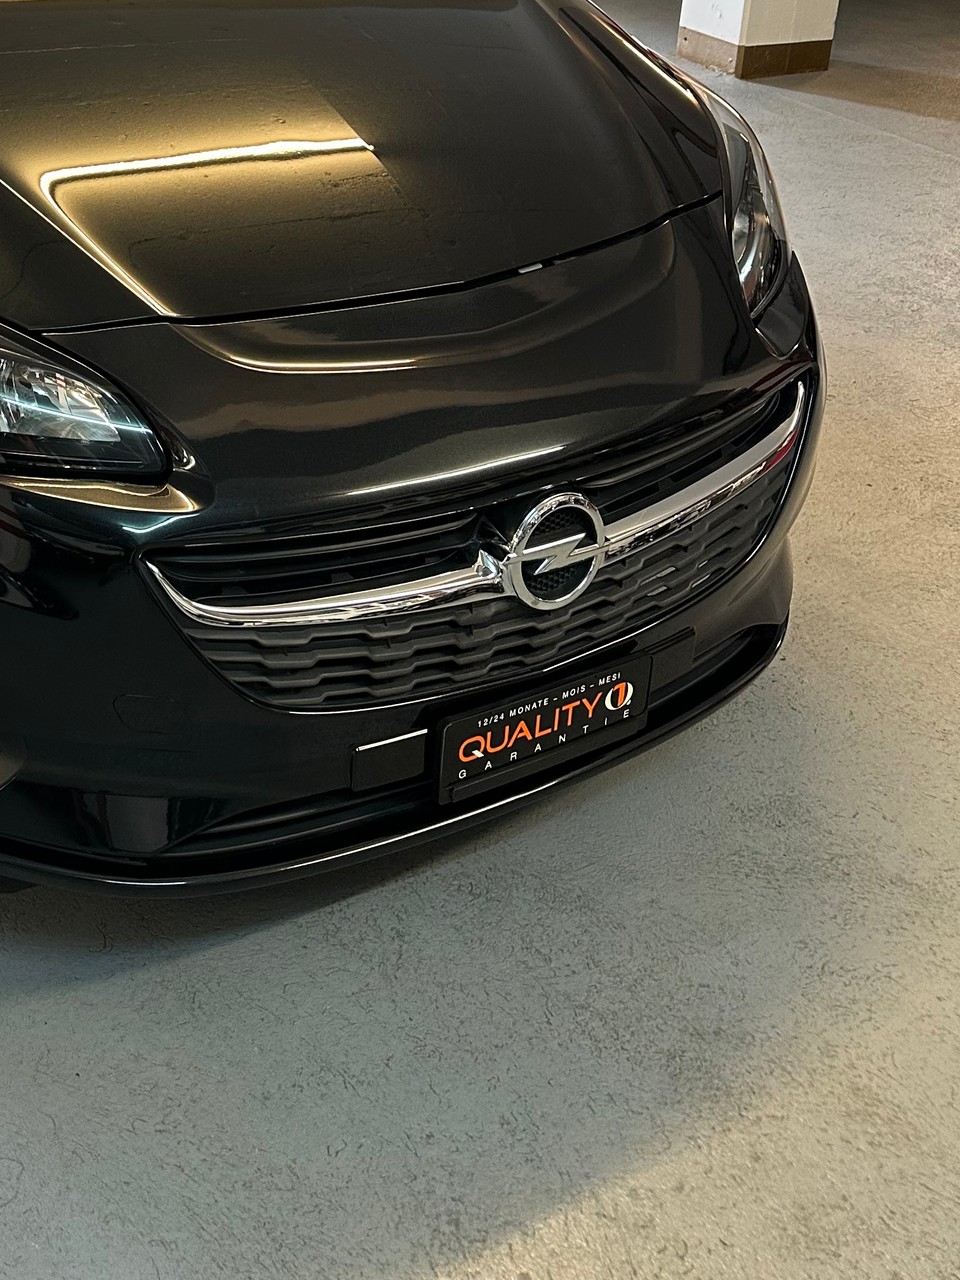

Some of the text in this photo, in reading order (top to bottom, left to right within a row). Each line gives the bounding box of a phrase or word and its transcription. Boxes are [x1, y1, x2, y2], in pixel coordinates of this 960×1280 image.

[458, 691, 603, 763] QUALITY
[477, 712, 505, 727] 12/24
[509, 697, 550, 717] MONATE
[562, 684, 586, 699] MOIS
[598, 672, 622, 686] MESI
[458, 708, 630, 780] GARANTIE
